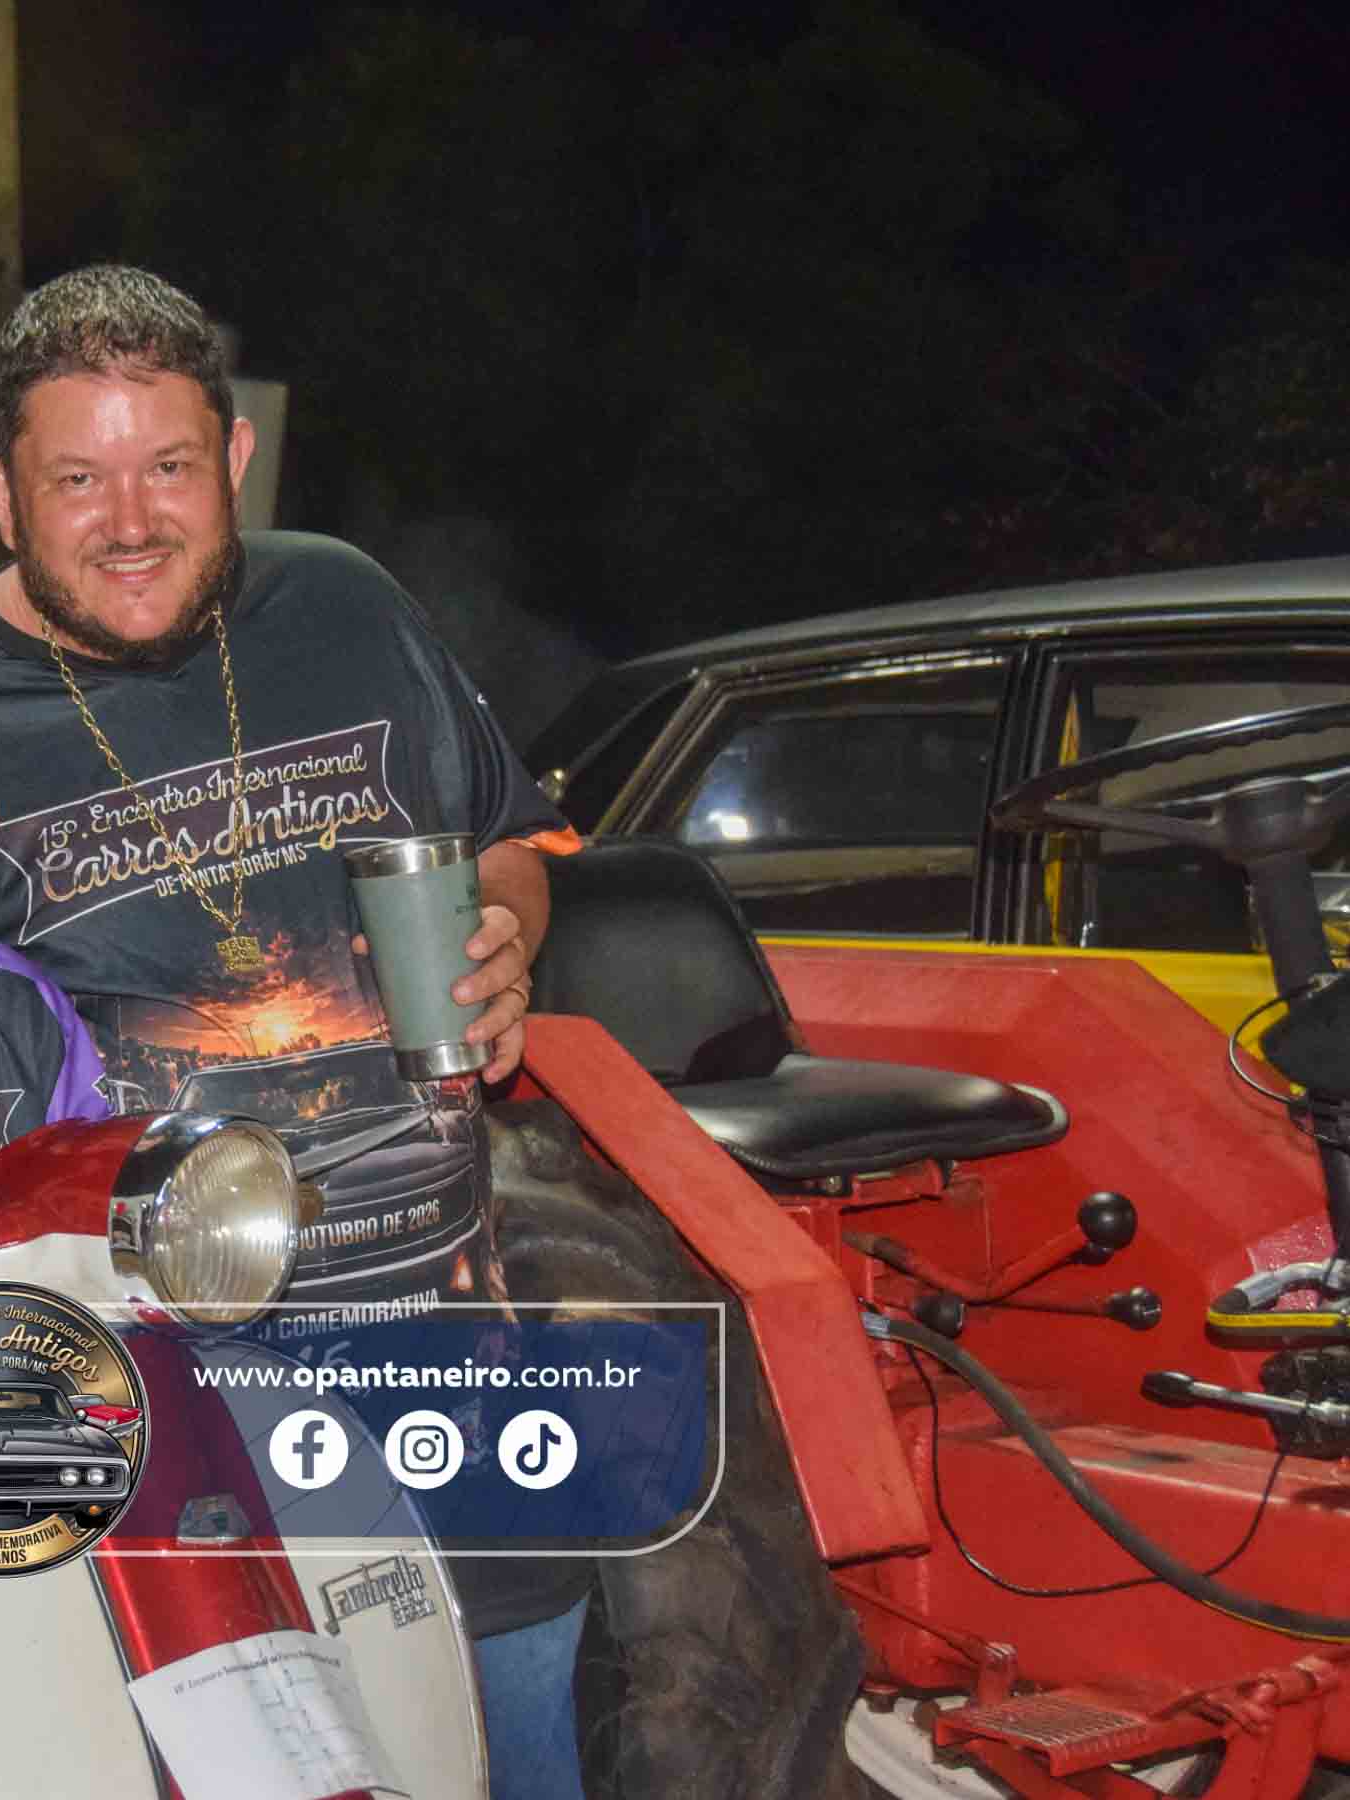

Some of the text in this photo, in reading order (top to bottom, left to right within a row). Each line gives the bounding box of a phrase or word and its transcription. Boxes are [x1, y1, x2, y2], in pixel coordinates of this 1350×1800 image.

[90, 784, 207, 834] Encontro
[206, 743, 367, 804] Internacional
[35, 783, 388, 902] Carros Antigos
[155, 876, 178, 897] DE
[234, 842, 307, 877] ORÃ/MS
[382, 1211, 404, 1237] DE
[279, 1287, 442, 1340] COMEMORATIVA
